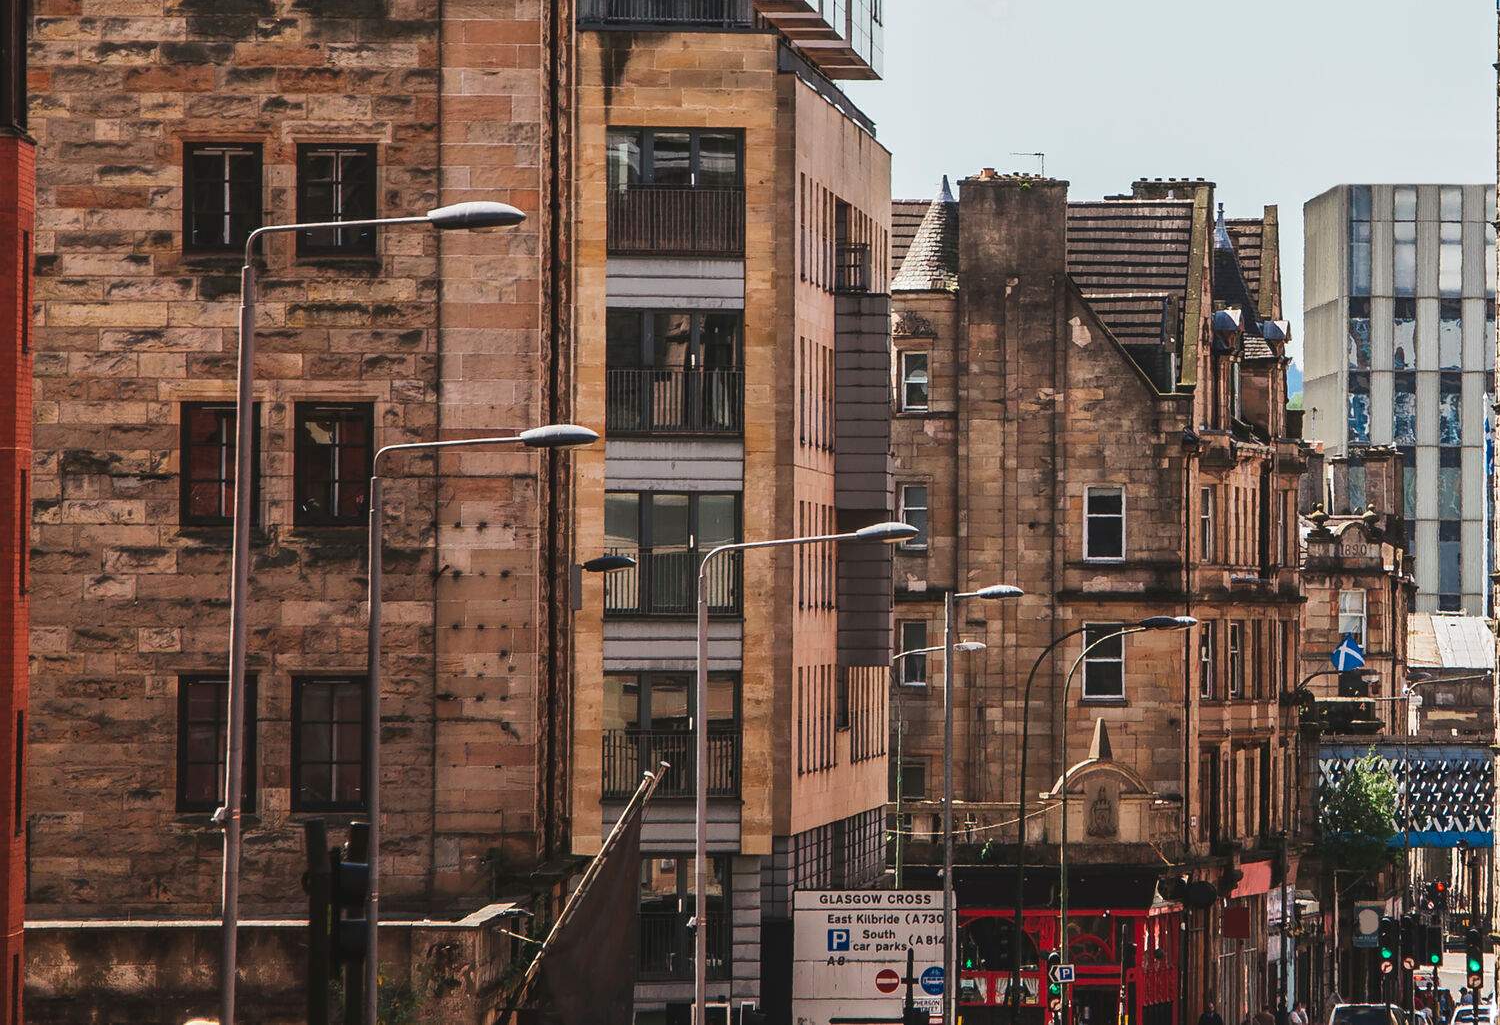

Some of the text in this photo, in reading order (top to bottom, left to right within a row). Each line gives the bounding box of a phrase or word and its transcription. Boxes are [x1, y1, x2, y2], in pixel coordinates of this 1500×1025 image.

[819, 894, 931, 904] GLASGOW CROSS
[828, 914, 852, 924] East
[856, 914, 900, 924] Kilbride
[862, 929, 896, 939] South
[833, 930, 847, 950] P
[853, 942, 908, 952] car parks
[1062, 969, 1070, 978] P
